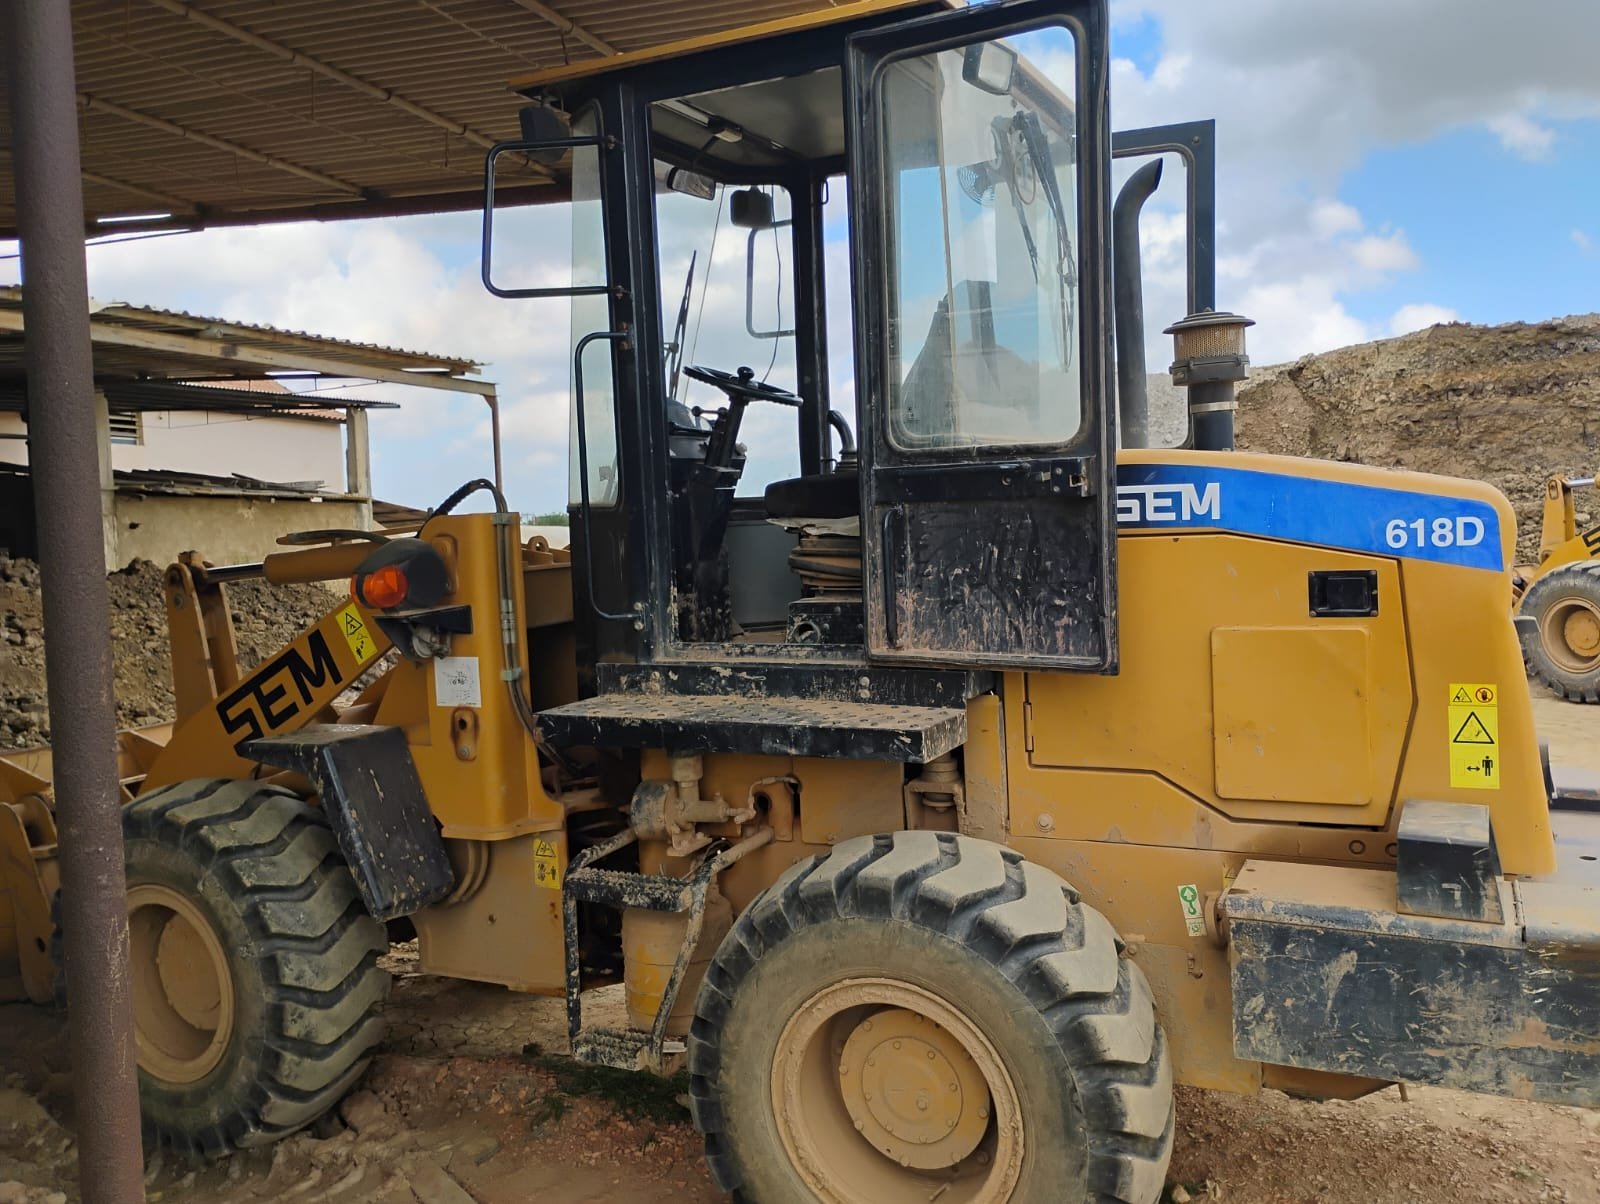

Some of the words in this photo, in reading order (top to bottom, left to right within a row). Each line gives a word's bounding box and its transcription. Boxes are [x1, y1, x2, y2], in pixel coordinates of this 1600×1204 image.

[1117, 482, 1220, 522] SEM
[1385, 516, 1485, 549] 618D
[216, 629, 343, 756] SEM
